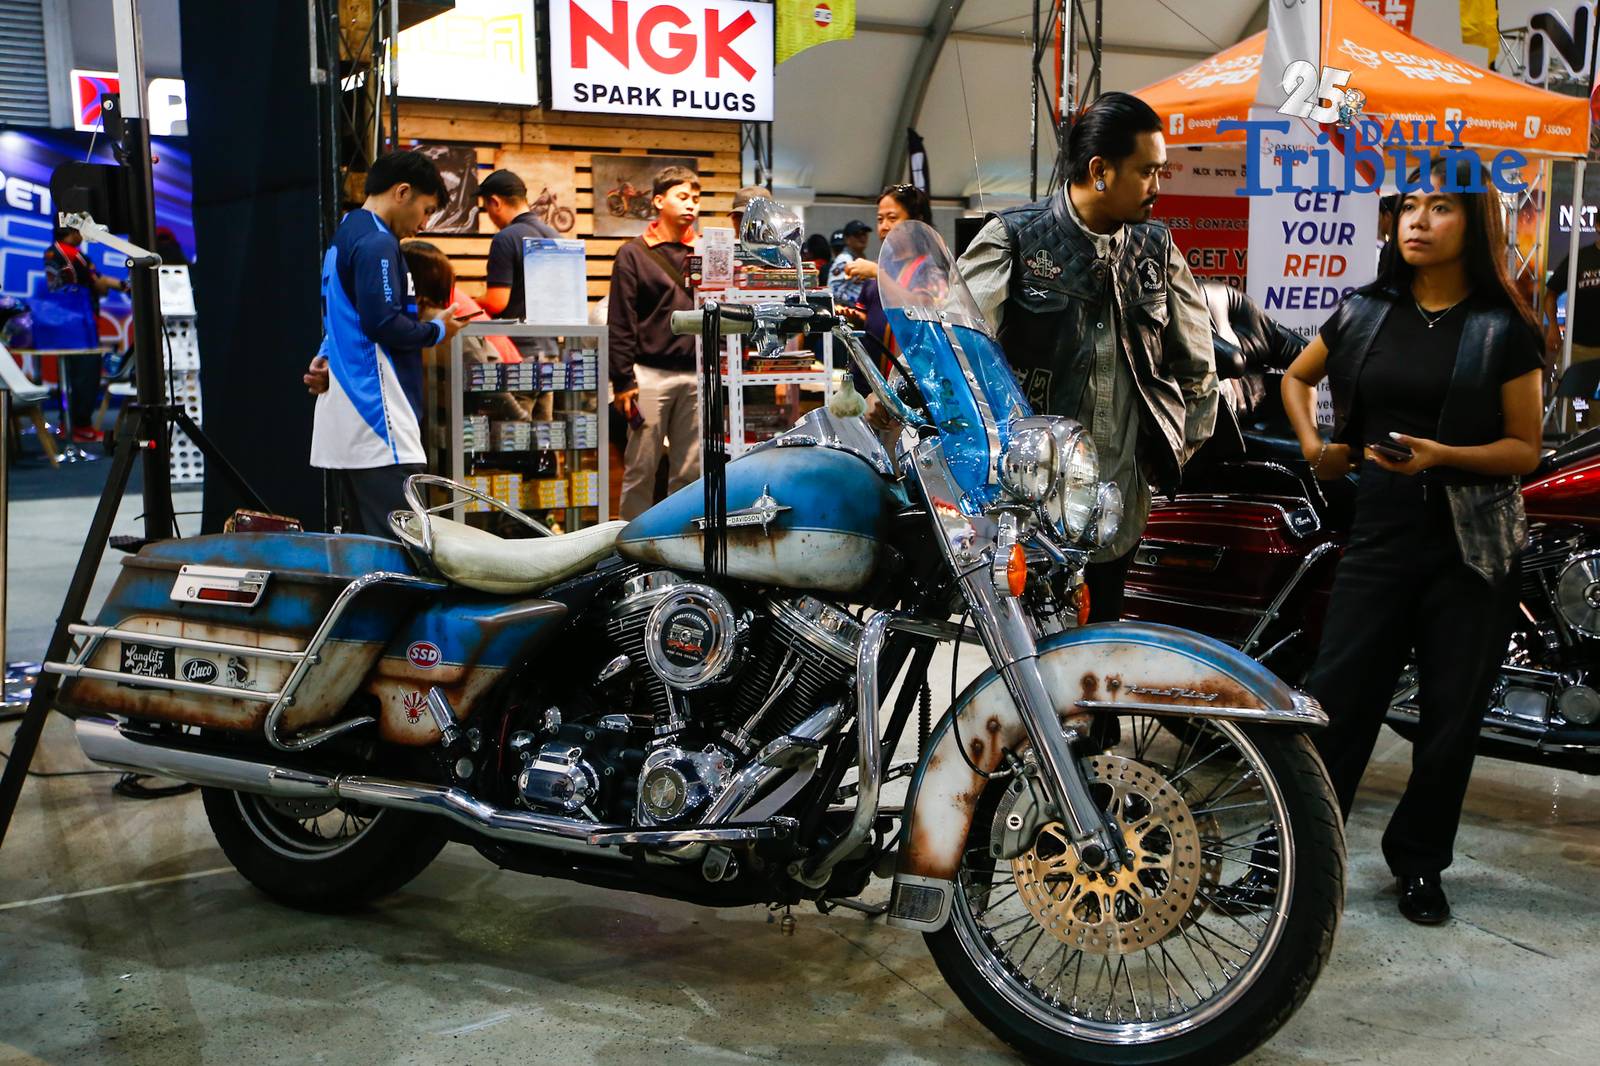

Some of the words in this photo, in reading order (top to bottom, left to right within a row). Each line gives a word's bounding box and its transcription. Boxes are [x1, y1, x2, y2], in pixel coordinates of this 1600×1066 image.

[569, 0, 757, 82] NGK
[573, 82, 663, 108] SPARK
[672, 89, 756, 113] PLUGS
[1294, 188, 1345, 213] GET
[1281, 220, 1356, 246] YOUR
[1186, 248, 1229, 269] GET
[1283, 253, 1347, 278] RFID
[381, 259, 393, 302] Bendix
[410, 647, 437, 661] SSD
[187, 660, 213, 680] Buco
